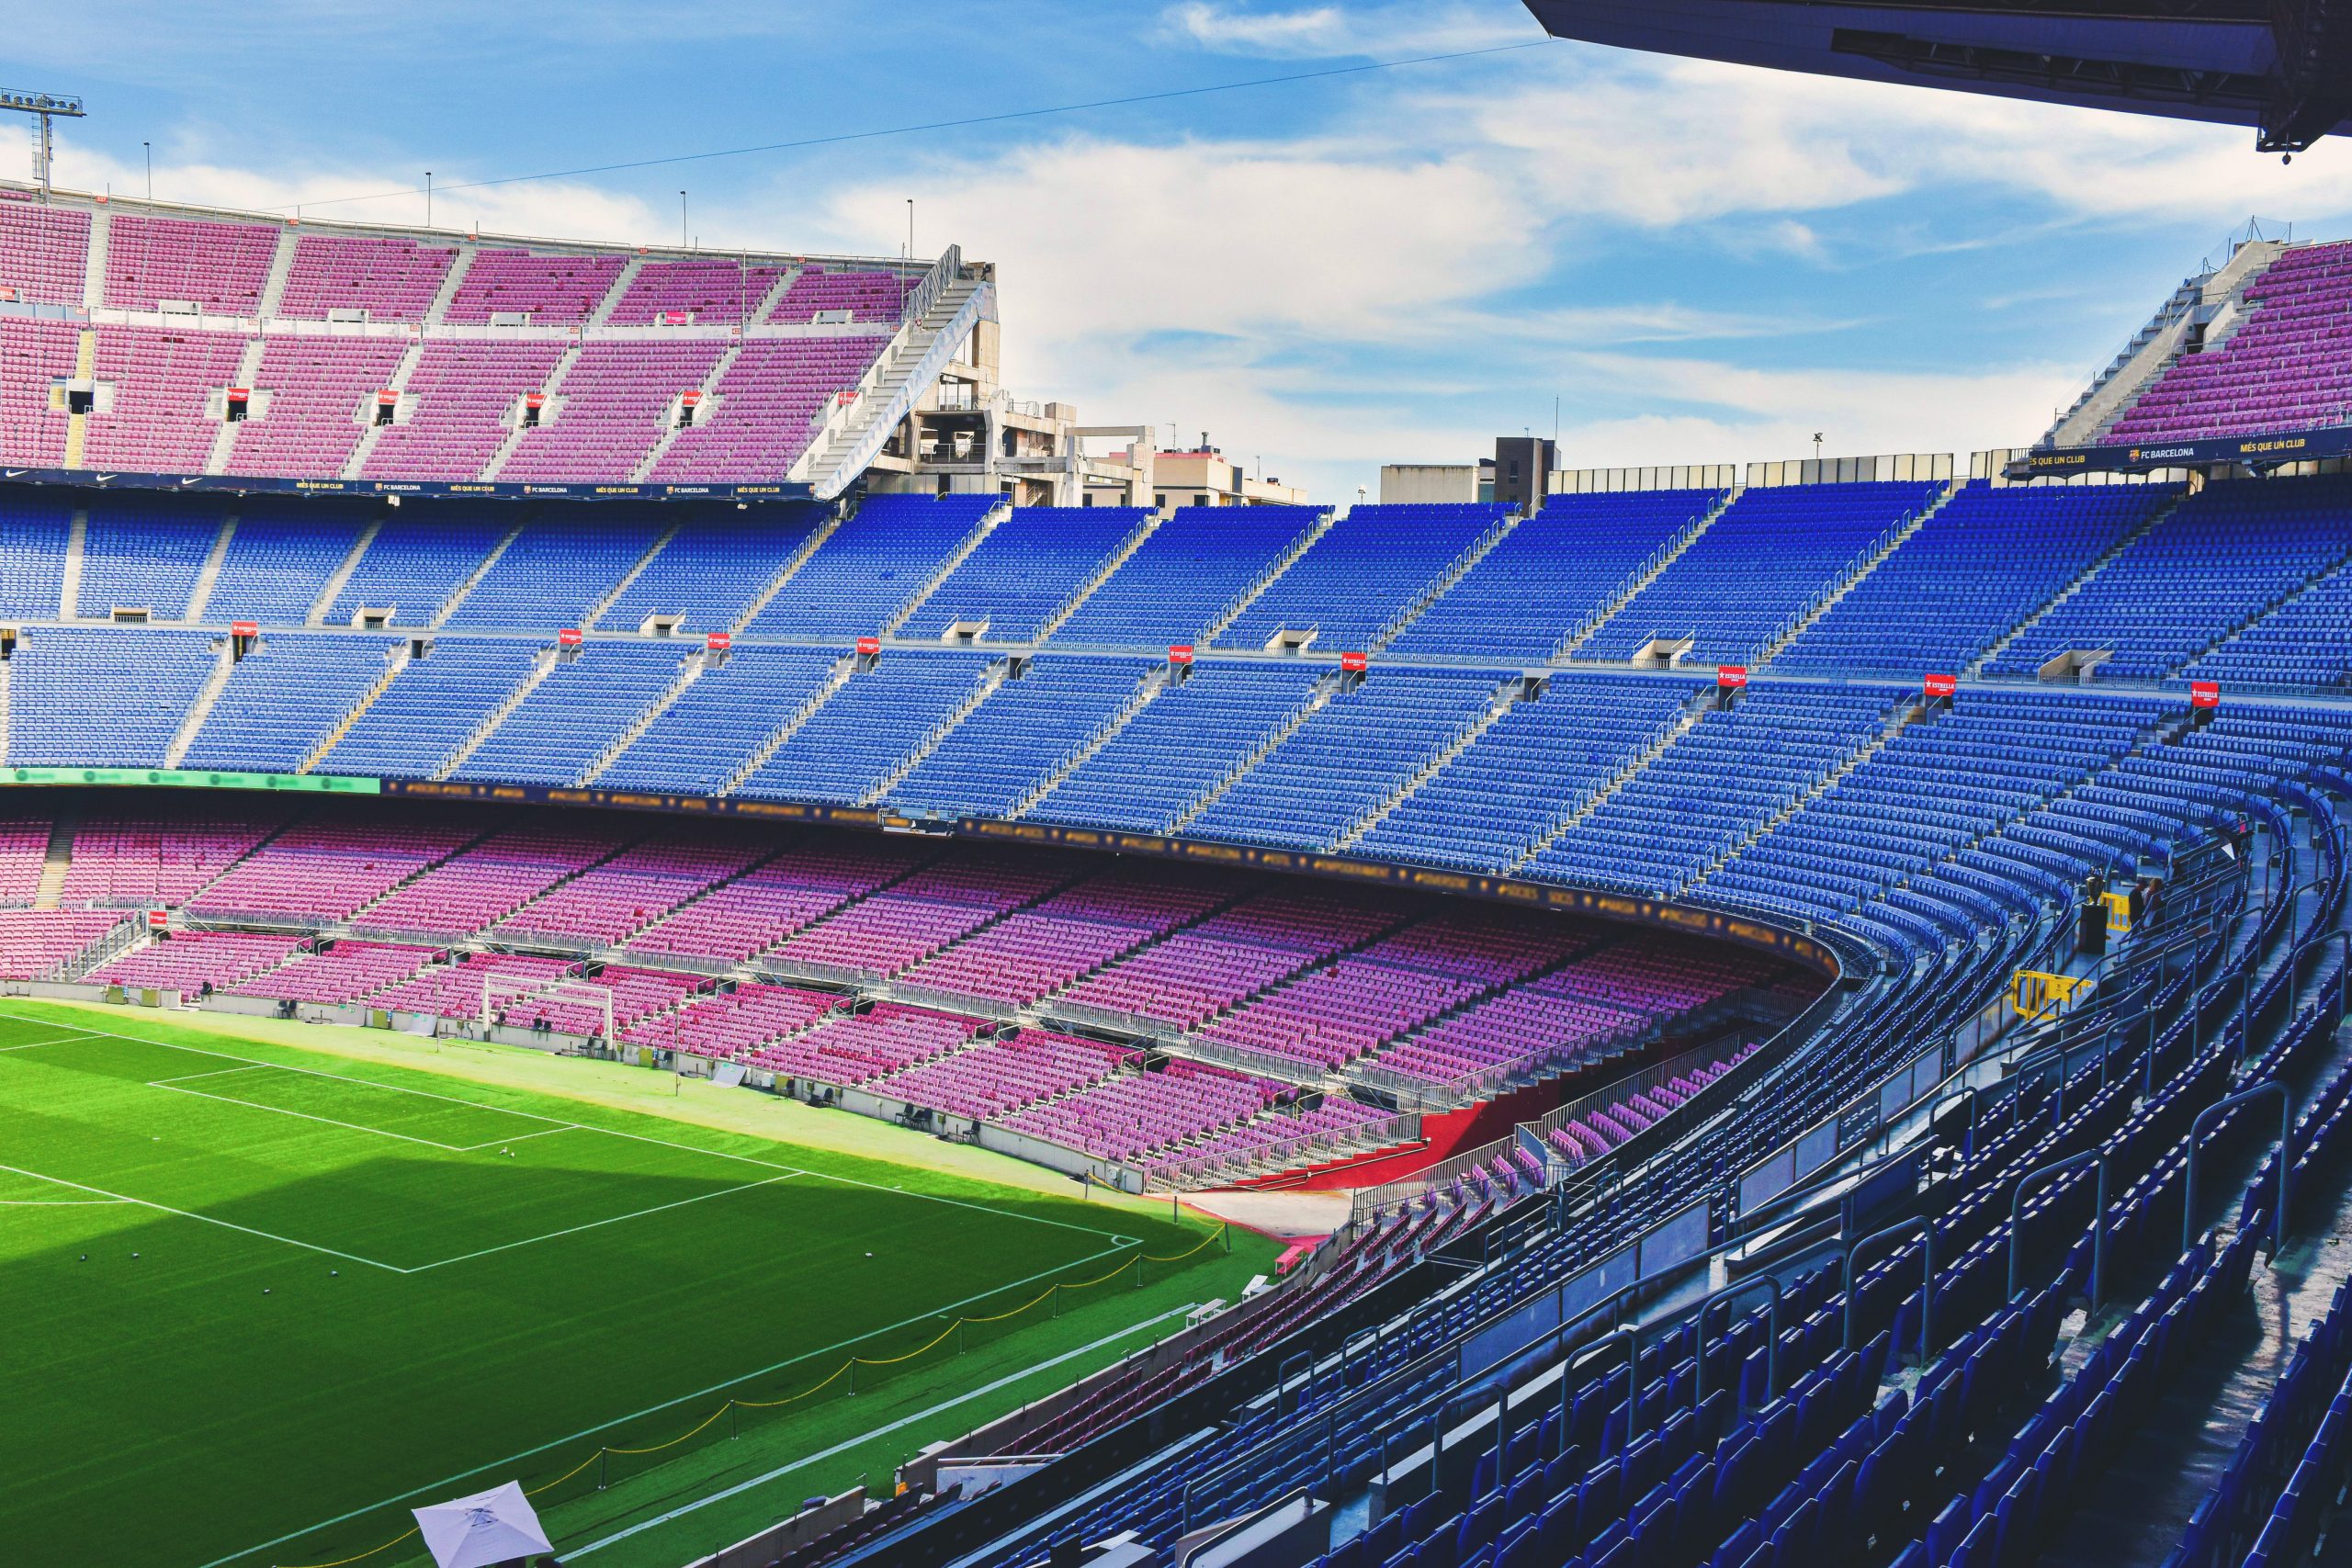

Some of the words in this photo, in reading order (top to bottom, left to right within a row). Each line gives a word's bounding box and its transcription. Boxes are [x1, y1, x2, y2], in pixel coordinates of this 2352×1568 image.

[2240, 442, 2256, 453] MÉS
[2257, 442, 2272, 452] QUE
[2273, 440, 2285, 449] UN
[2286, 438, 2305, 448] CLUB
[2141, 451, 2150, 459] FC
[2151, 447, 2194, 458] BARCELONA
[2038, 457, 2052, 467] QUE
[2054, 457, 2065, 465] UN
